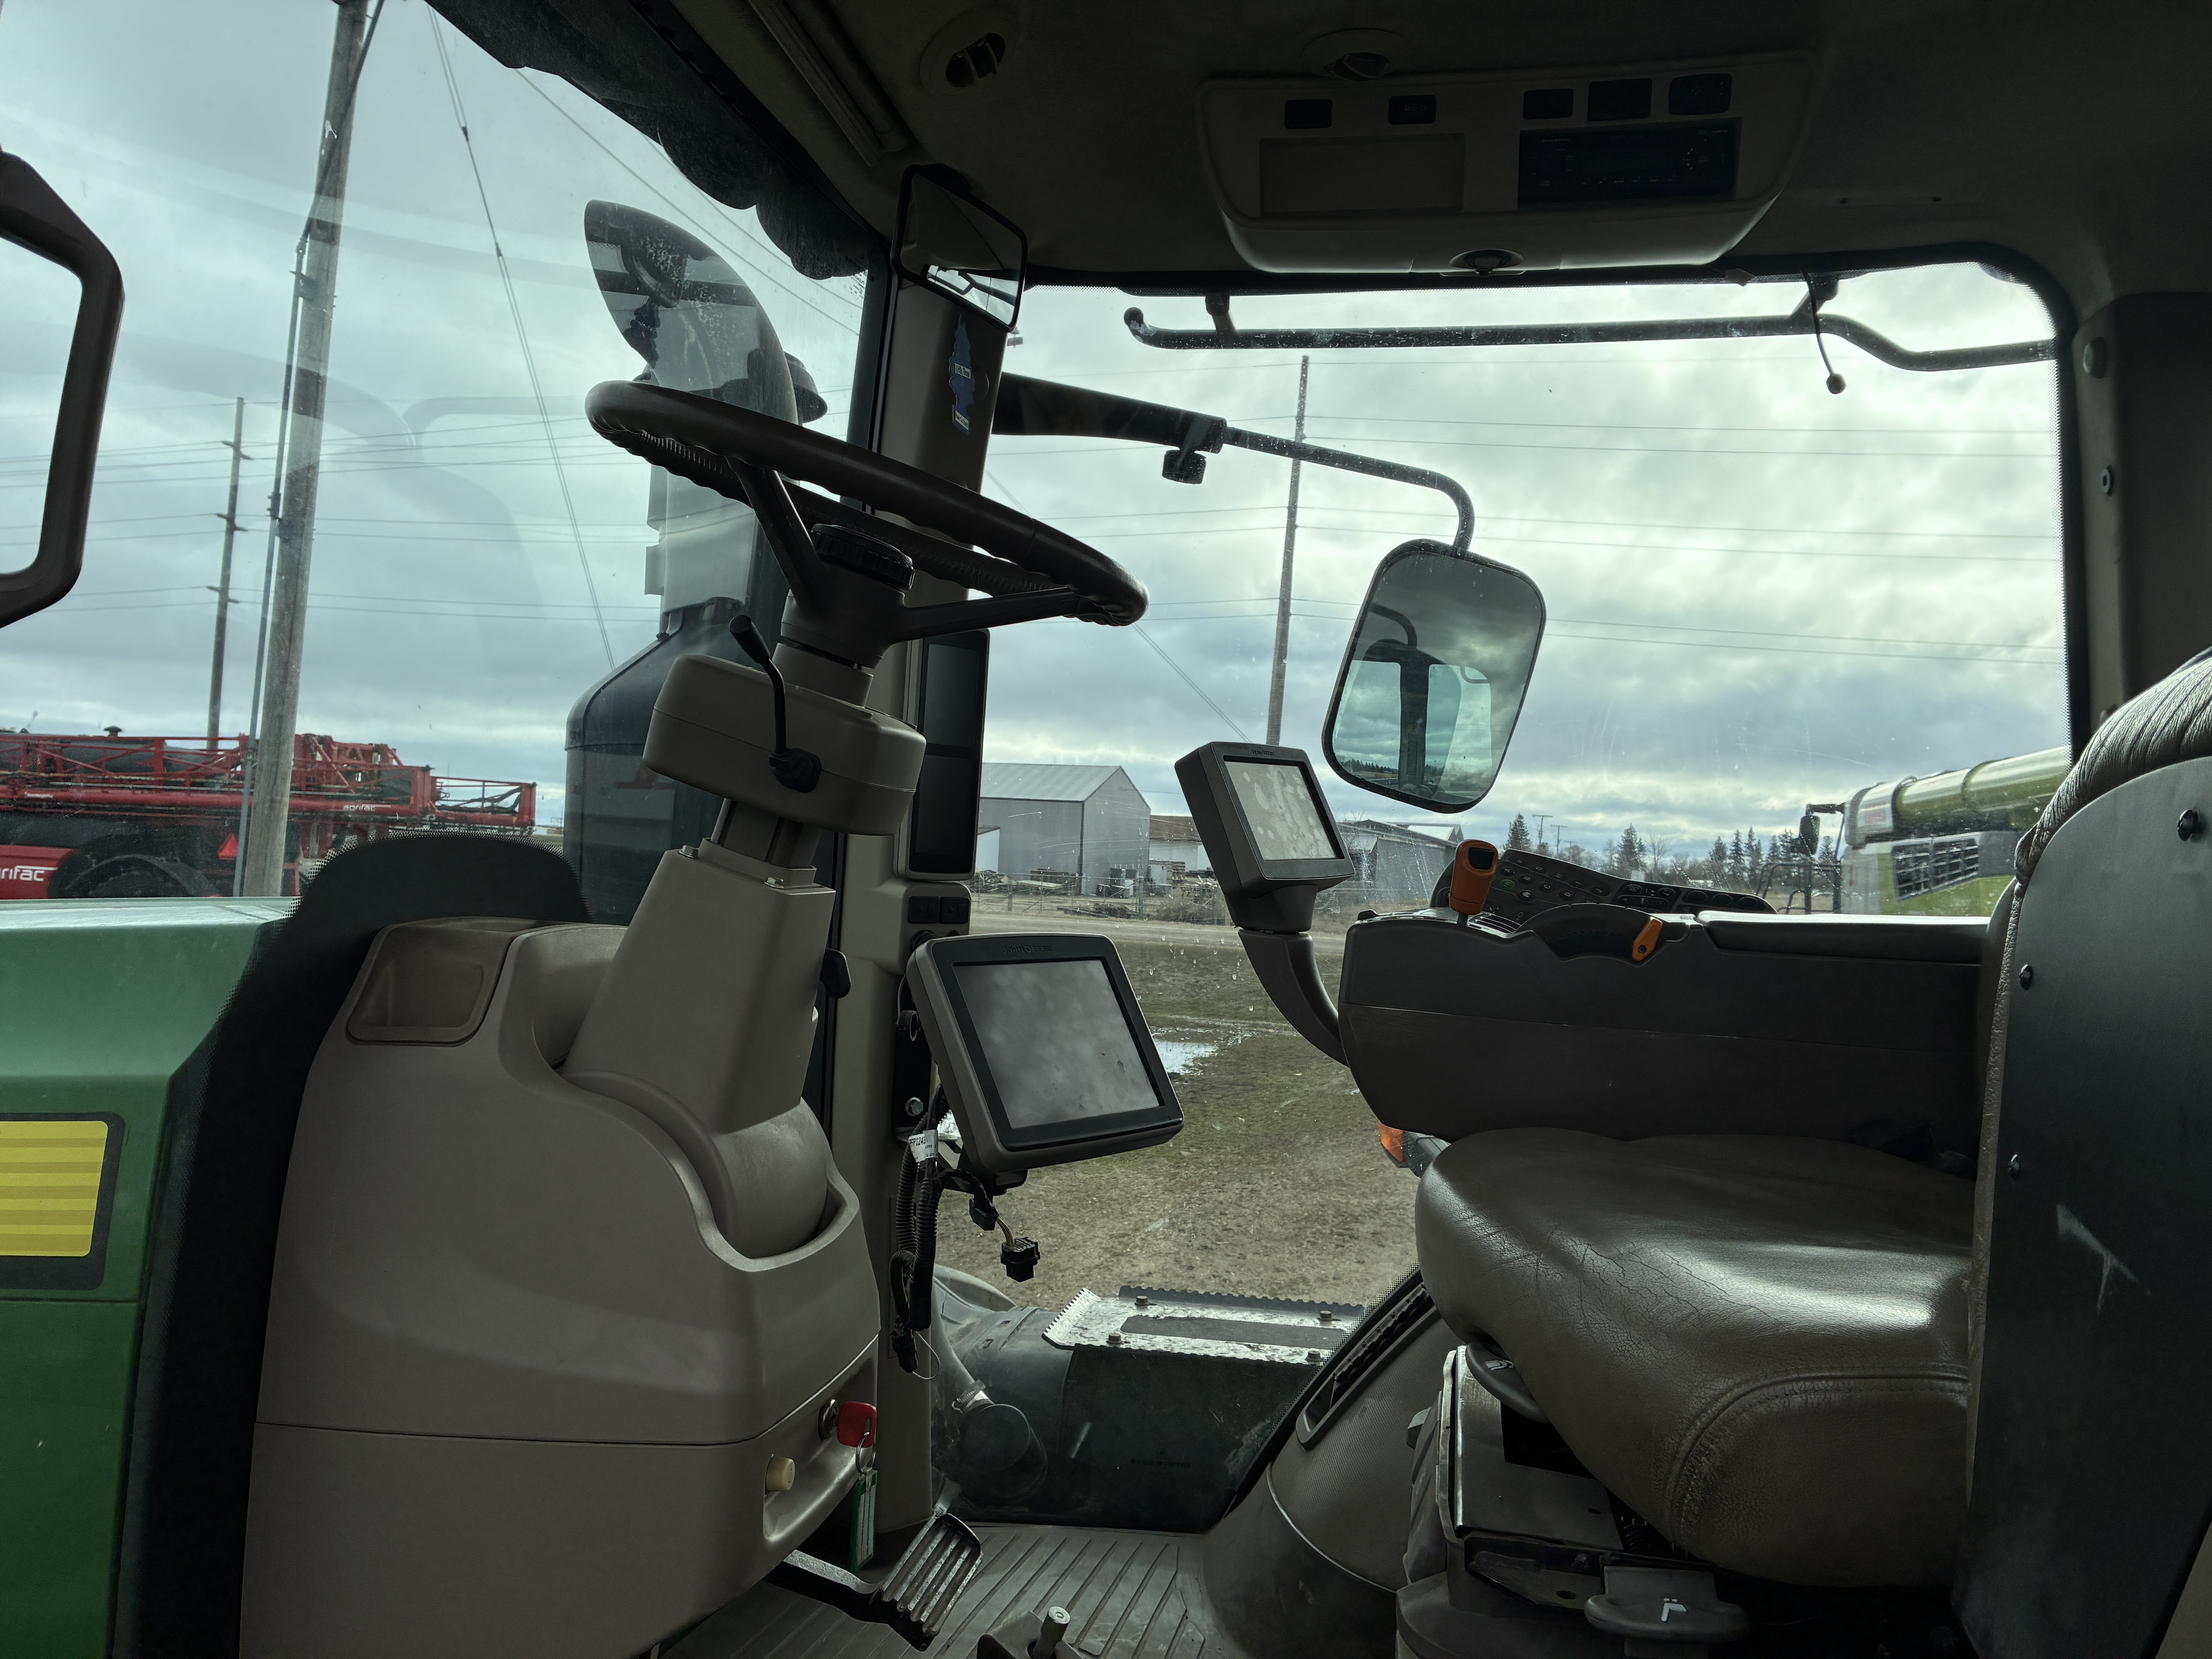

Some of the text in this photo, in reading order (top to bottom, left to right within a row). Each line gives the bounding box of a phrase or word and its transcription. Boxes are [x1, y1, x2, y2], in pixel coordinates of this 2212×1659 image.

[0, 865, 58, 882] rifac
[1003, 945, 1053, 954] JOHN DEERE
